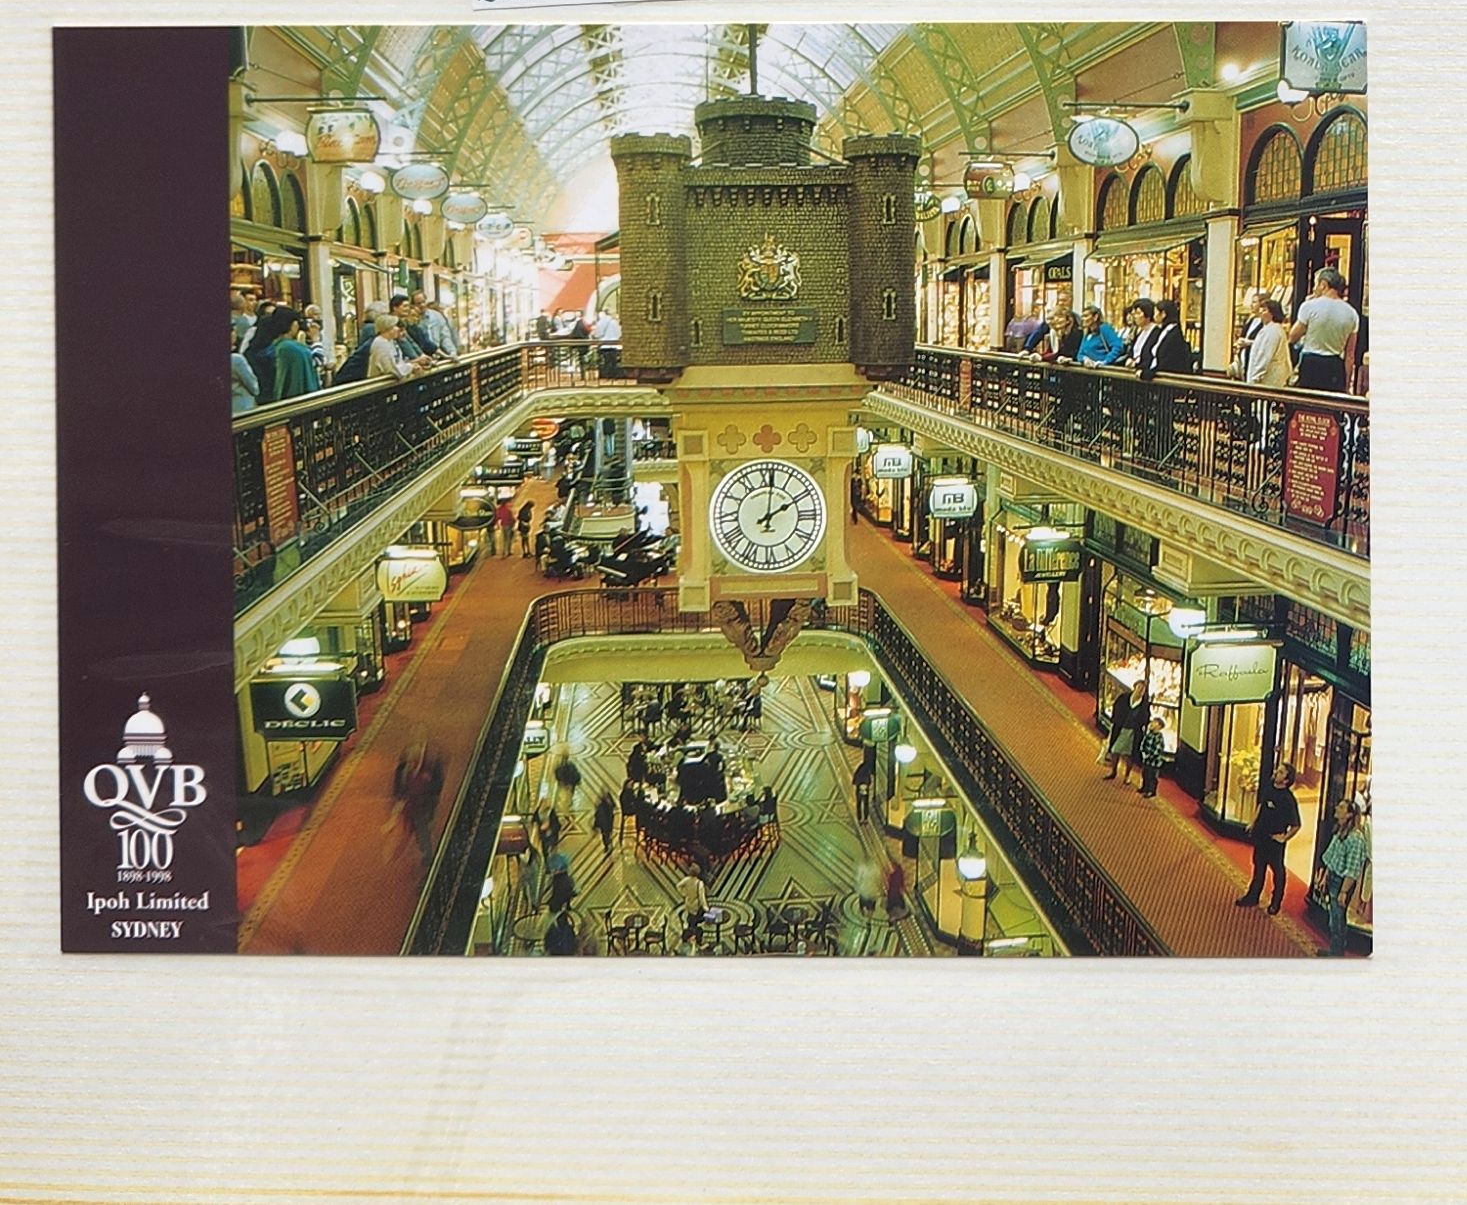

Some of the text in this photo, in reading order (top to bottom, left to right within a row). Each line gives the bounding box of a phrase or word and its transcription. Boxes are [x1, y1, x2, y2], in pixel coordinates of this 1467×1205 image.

[1048, 266, 1072, 279] OPALS
[1024, 548, 1036, 573] La
[524, 736, 546, 745] ALLY
[84, 763, 207, 810] QVB
[116, 829, 174, 870] 100
[117, 870, 173, 884] 1898-1998
[86, 891, 210, 915] Ipoh Limited
[111, 921, 184, 939] SYDNEY
